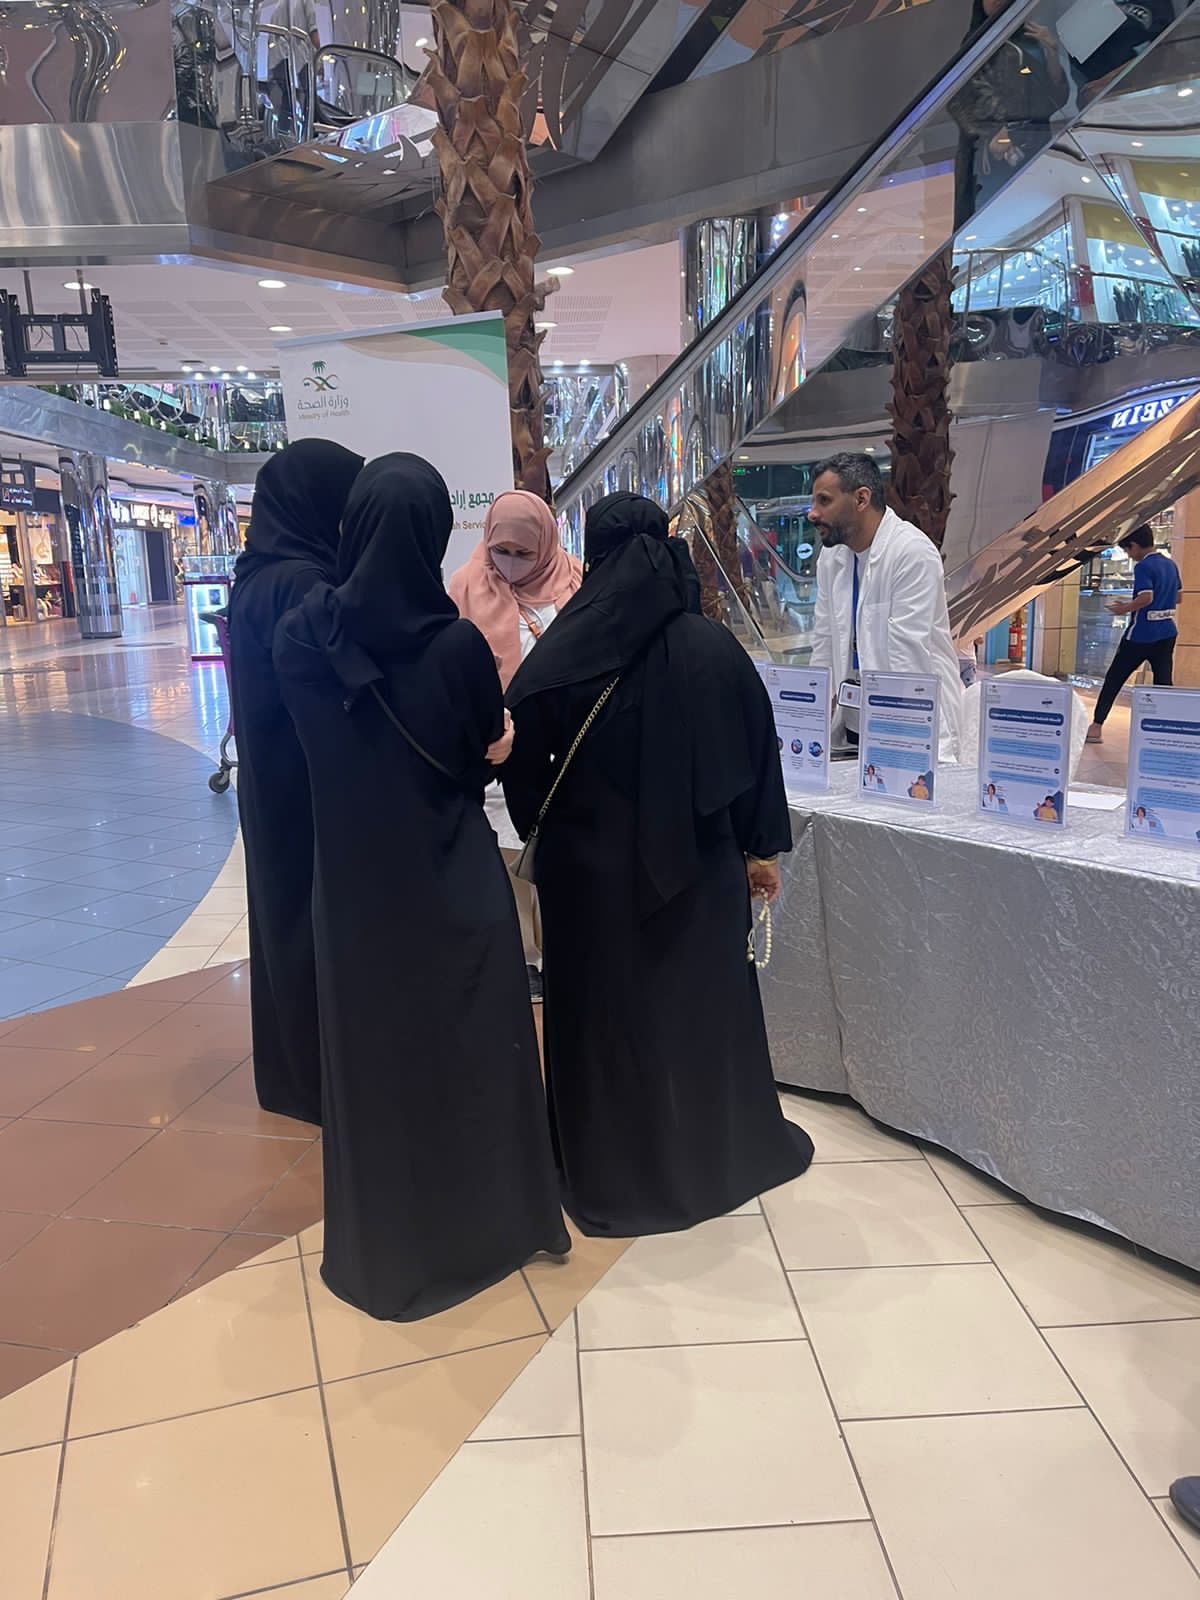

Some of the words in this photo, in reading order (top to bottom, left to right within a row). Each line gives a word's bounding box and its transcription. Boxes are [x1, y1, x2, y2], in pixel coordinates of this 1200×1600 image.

[297, 394, 327, 410] الصحة
[328, 394, 349, 409] وزارة
[450, 489, 466, 511] إراد
[468, 492, 494, 508] مجمع
[462, 521, 487, 529] Servic
